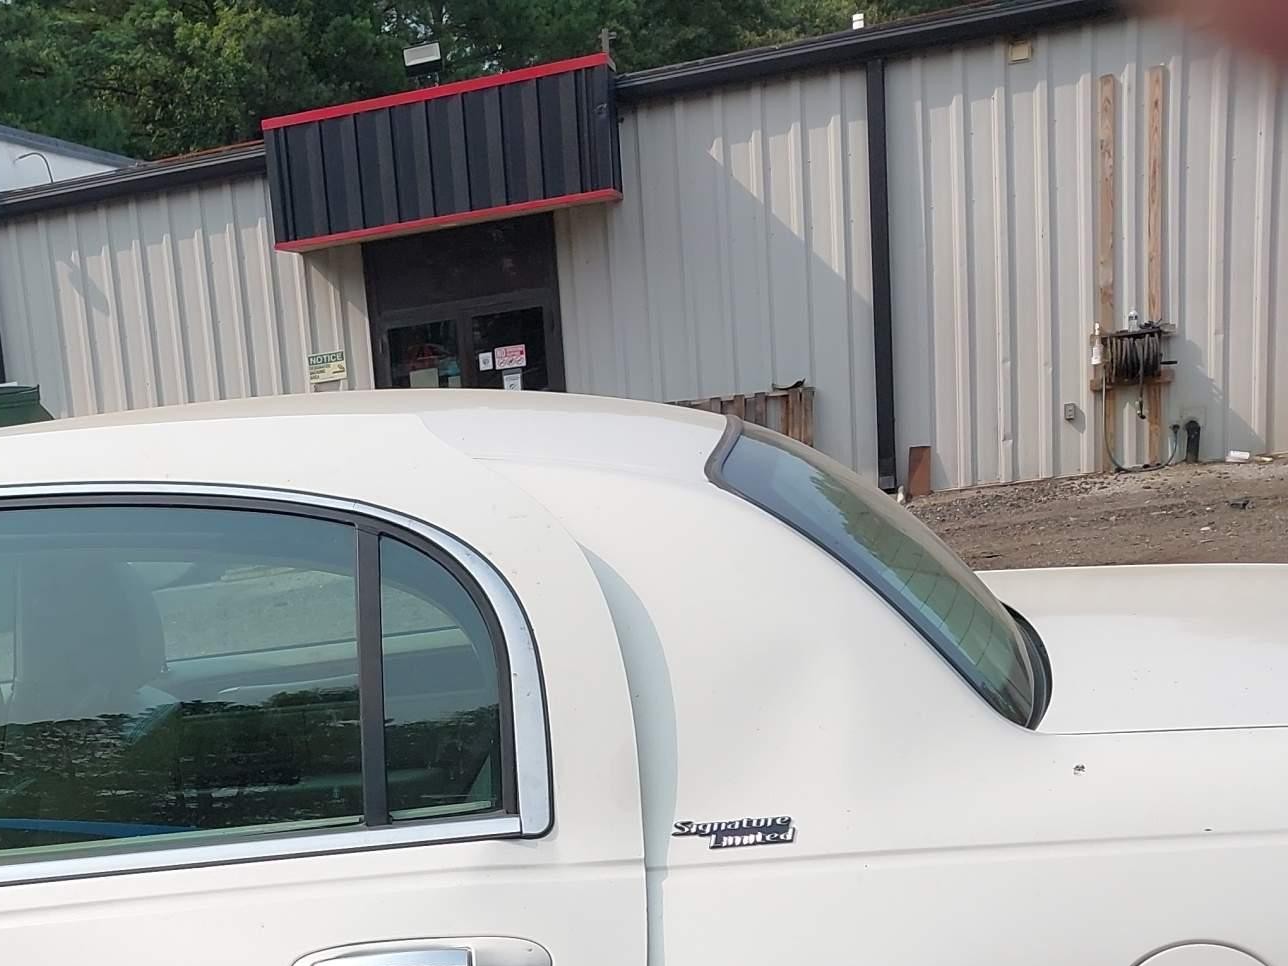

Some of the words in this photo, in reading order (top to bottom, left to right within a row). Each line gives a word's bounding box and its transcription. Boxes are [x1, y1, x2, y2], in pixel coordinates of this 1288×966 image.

[310, 352, 343, 365] NOTICE
[672, 816, 792, 837] Signature
[709, 826, 795, 849] Limited
